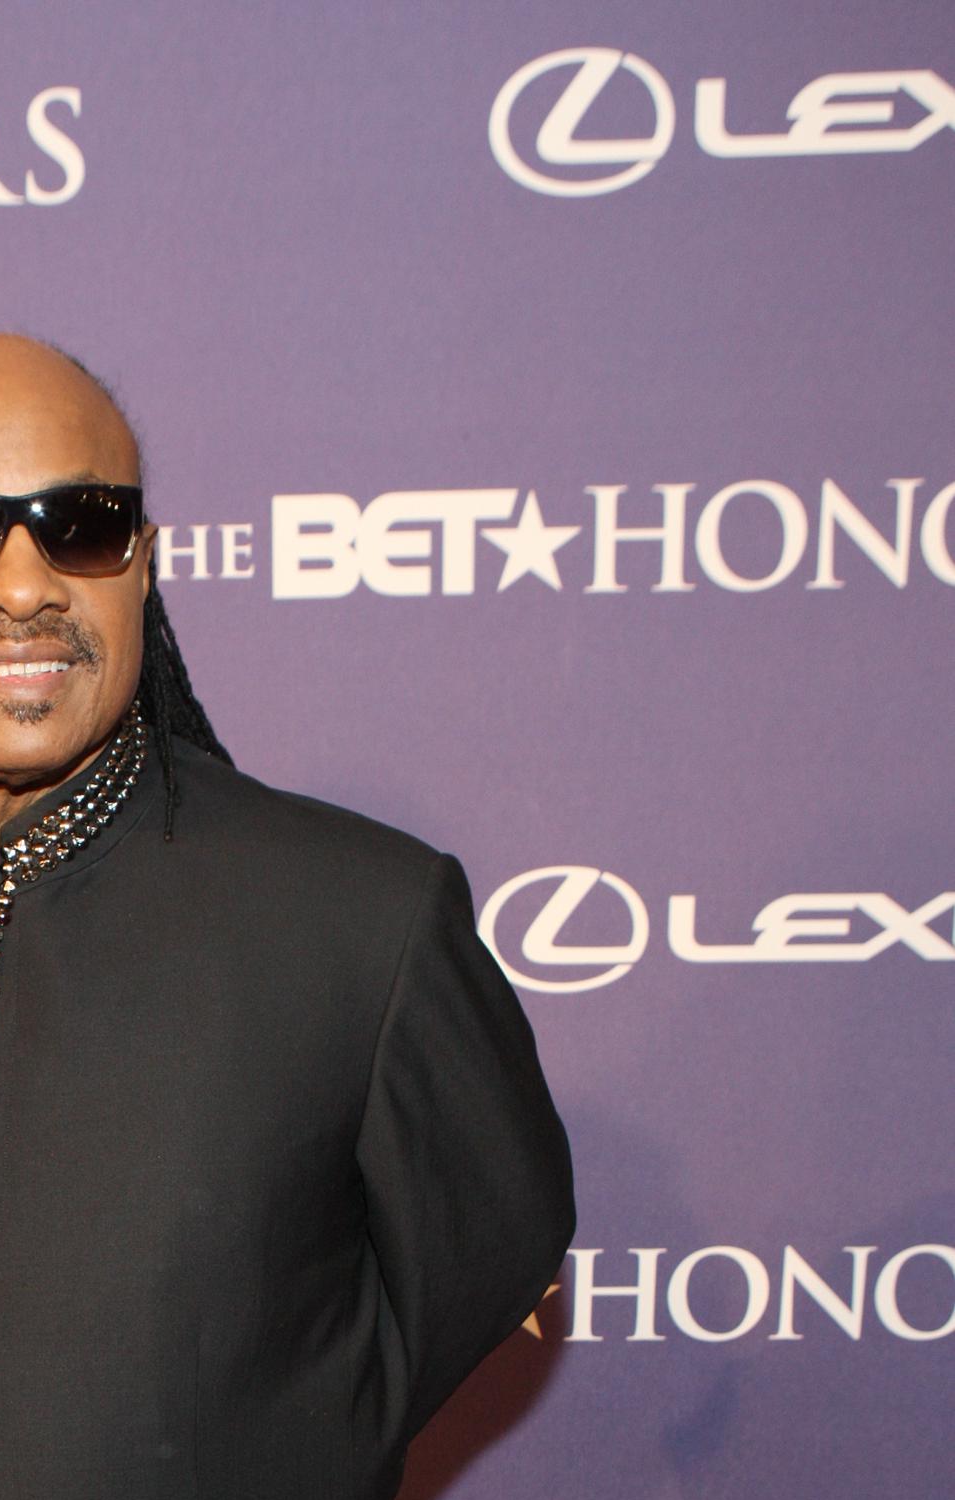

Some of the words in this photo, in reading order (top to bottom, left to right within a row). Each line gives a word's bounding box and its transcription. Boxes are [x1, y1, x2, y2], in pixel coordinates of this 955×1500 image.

[271, 488, 519, 601] BET
[667, 891, 955, 963] LEX
[563, 1243, 955, 1343] HONO
